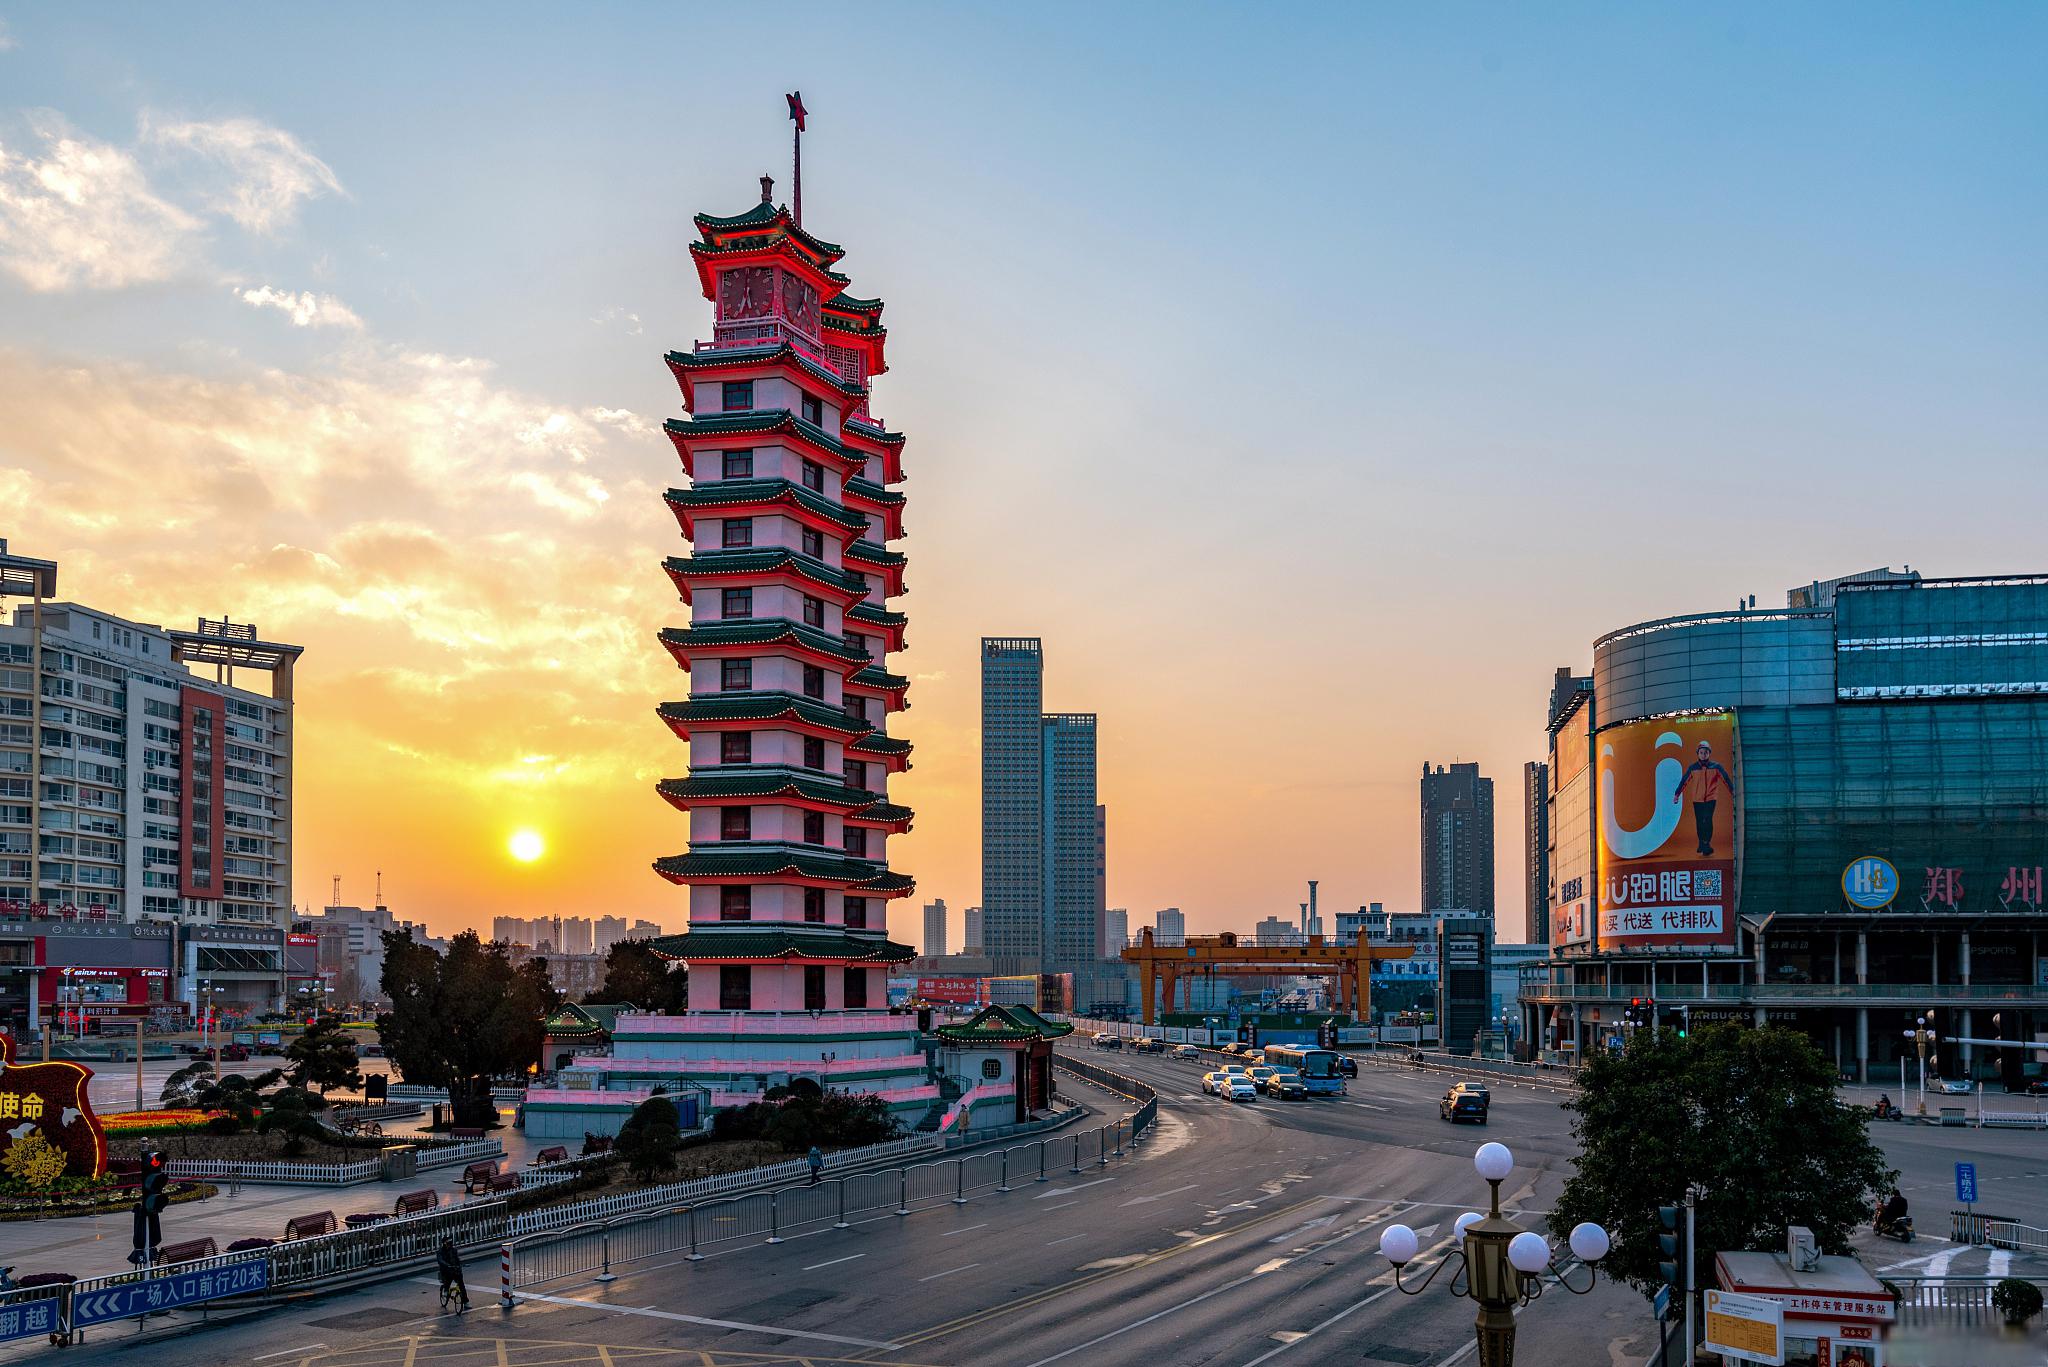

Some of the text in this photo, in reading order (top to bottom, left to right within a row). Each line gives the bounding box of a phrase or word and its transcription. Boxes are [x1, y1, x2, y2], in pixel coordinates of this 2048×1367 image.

[1926, 866, 2043, 906] 郑州
[1624, 912, 1652, 931] 代送
[1661, 911, 1718, 929] 代排队
[0, 1091, 44, 1120] 使命
[1960, 1166, 1973, 1200] 二七路方向
[128, 1264, 262, 1310] 广场入口前行20米
[1708, 1291, 1719, 1311] P
[0, 1305, 49, 1336] 翻越
[1791, 1299, 1886, 1315] 工作停车管理服务站
